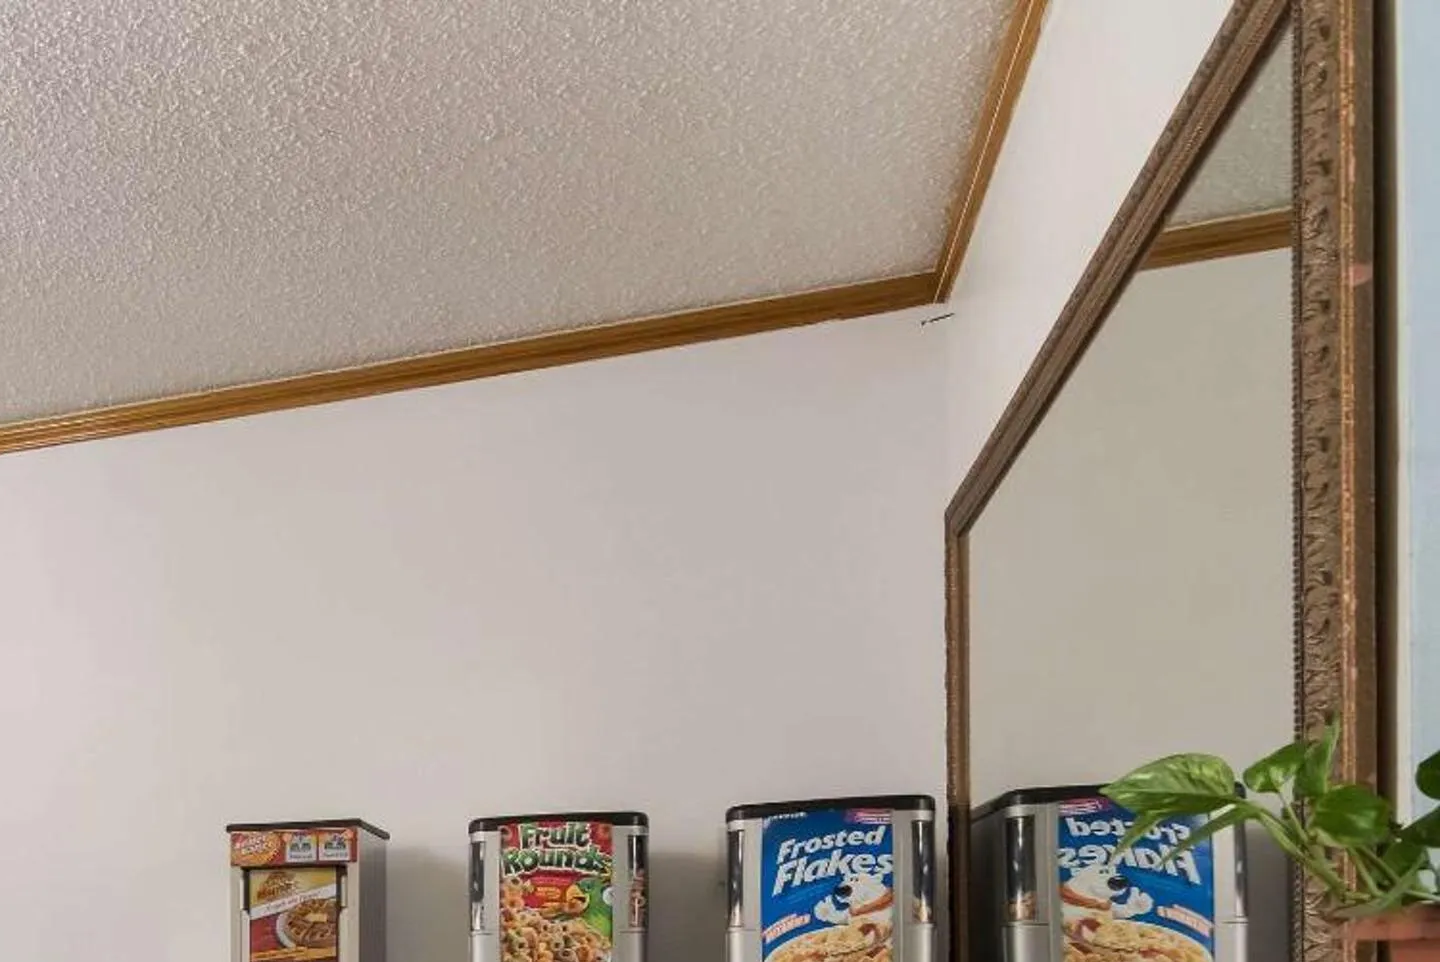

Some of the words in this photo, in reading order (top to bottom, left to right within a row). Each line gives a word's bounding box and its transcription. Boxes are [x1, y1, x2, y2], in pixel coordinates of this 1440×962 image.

[519, 822, 591, 851] Fruit
[775, 825, 886, 864] Frosted
[502, 844, 613, 878] Rounds
[771, 848, 893, 897] Flakes
